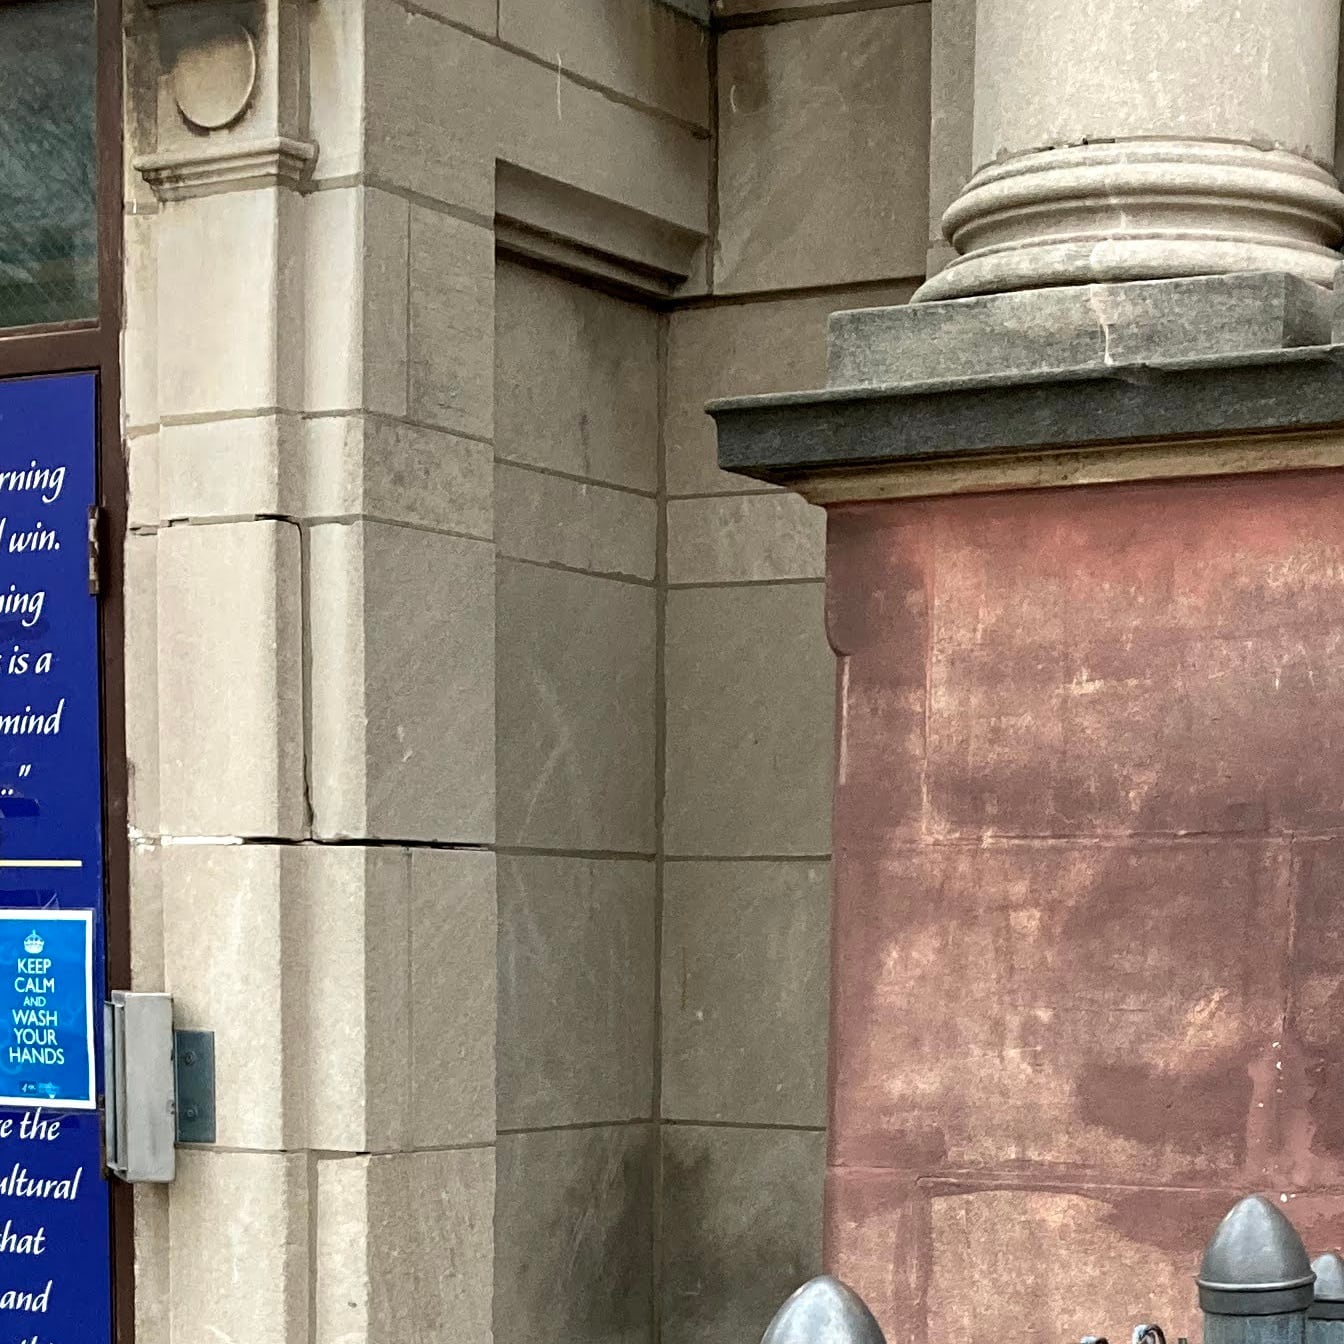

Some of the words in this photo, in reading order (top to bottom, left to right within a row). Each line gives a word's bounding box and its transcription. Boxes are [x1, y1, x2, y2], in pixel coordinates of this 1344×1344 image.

[9, 522, 61, 553] win.
[8, 649, 29, 675] is
[34, 650, 52, 674] a
[18, 958, 52, 974] KEEP
[14, 977, 55, 993] CALM
[23, 996, 47, 1007] AND
[12, 1009, 57, 1027] WASH
[14, 1028, 58, 1046] YOUR
[9, 1047, 65, 1065] HANDS
[18, 1107, 61, 1142] the
[0, 1280, 53, 1313] and
